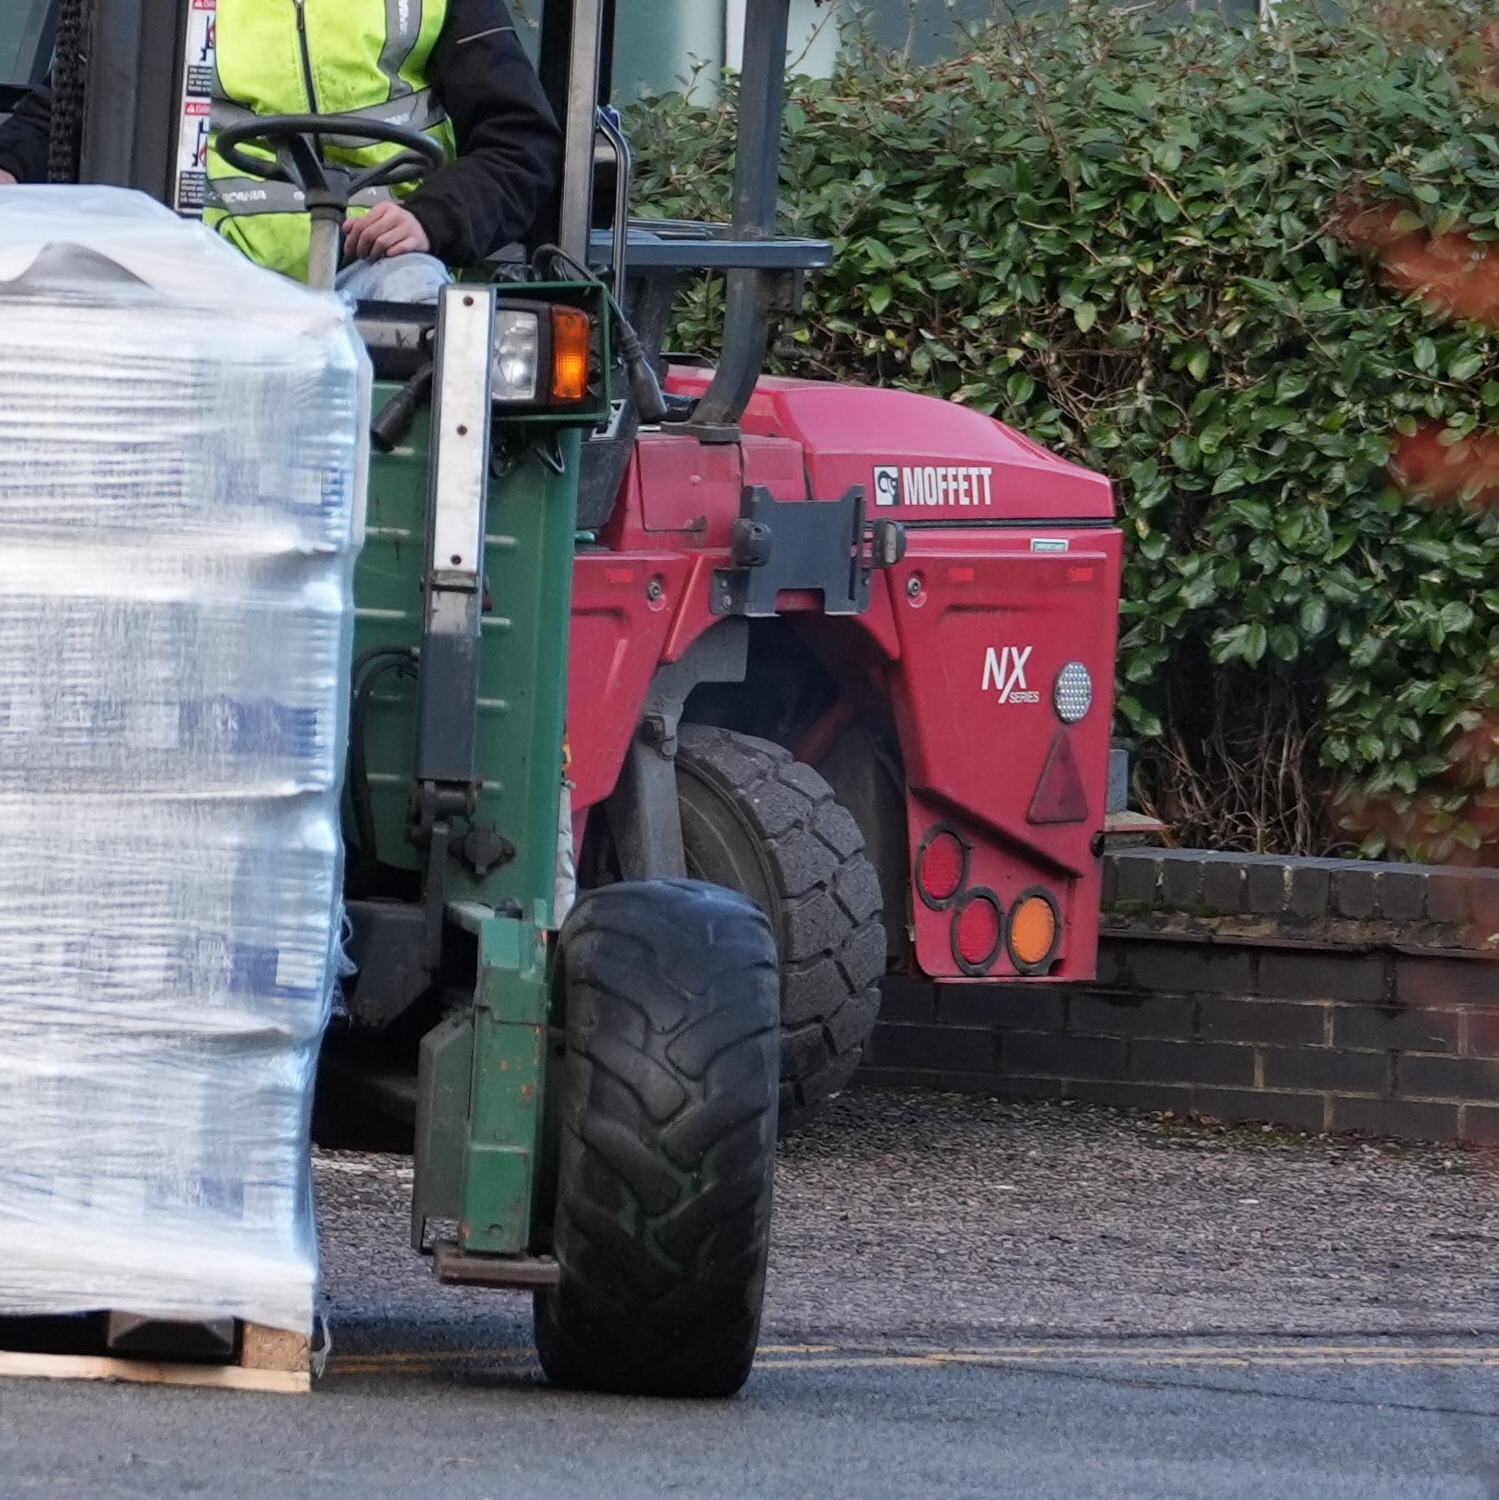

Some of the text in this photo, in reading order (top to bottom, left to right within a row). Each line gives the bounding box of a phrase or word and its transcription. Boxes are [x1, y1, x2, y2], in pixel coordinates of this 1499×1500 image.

[901, 466, 993, 507] MOFFETT
[981, 645, 1034, 704] NX
[1008, 691, 1040, 704] SERIES
